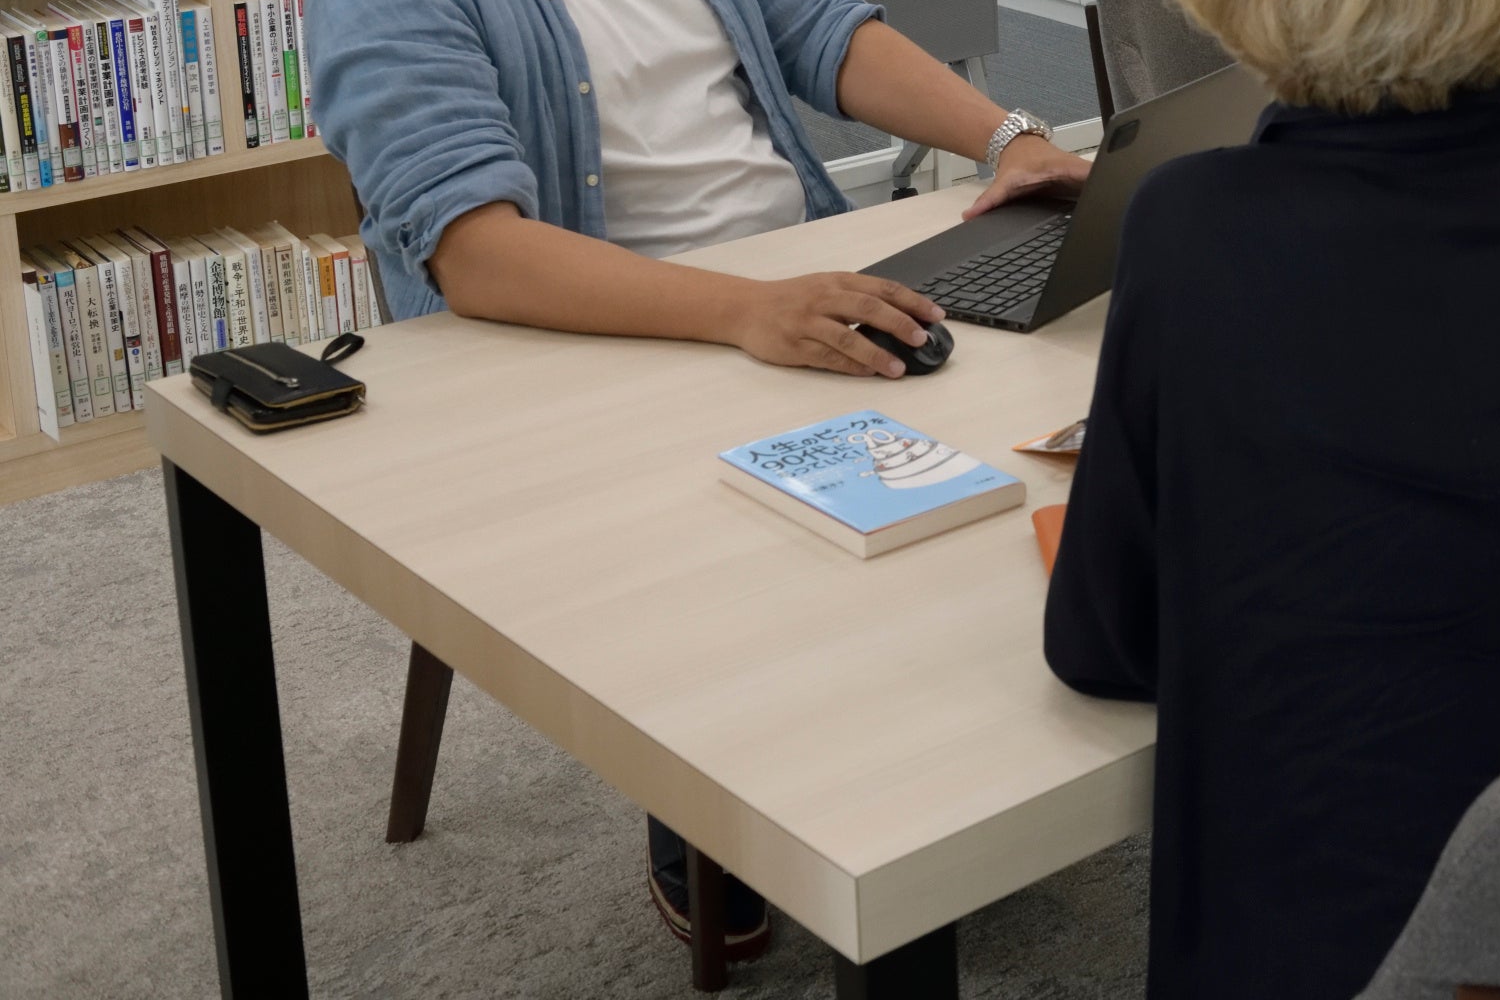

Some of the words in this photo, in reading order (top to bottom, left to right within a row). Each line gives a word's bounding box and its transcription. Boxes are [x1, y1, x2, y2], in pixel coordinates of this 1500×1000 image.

[101, 62, 115, 108] 事業計画書
[210, 261, 226, 319] 企業博物館
[231, 261, 250, 345] 戦争と平和の世界史
